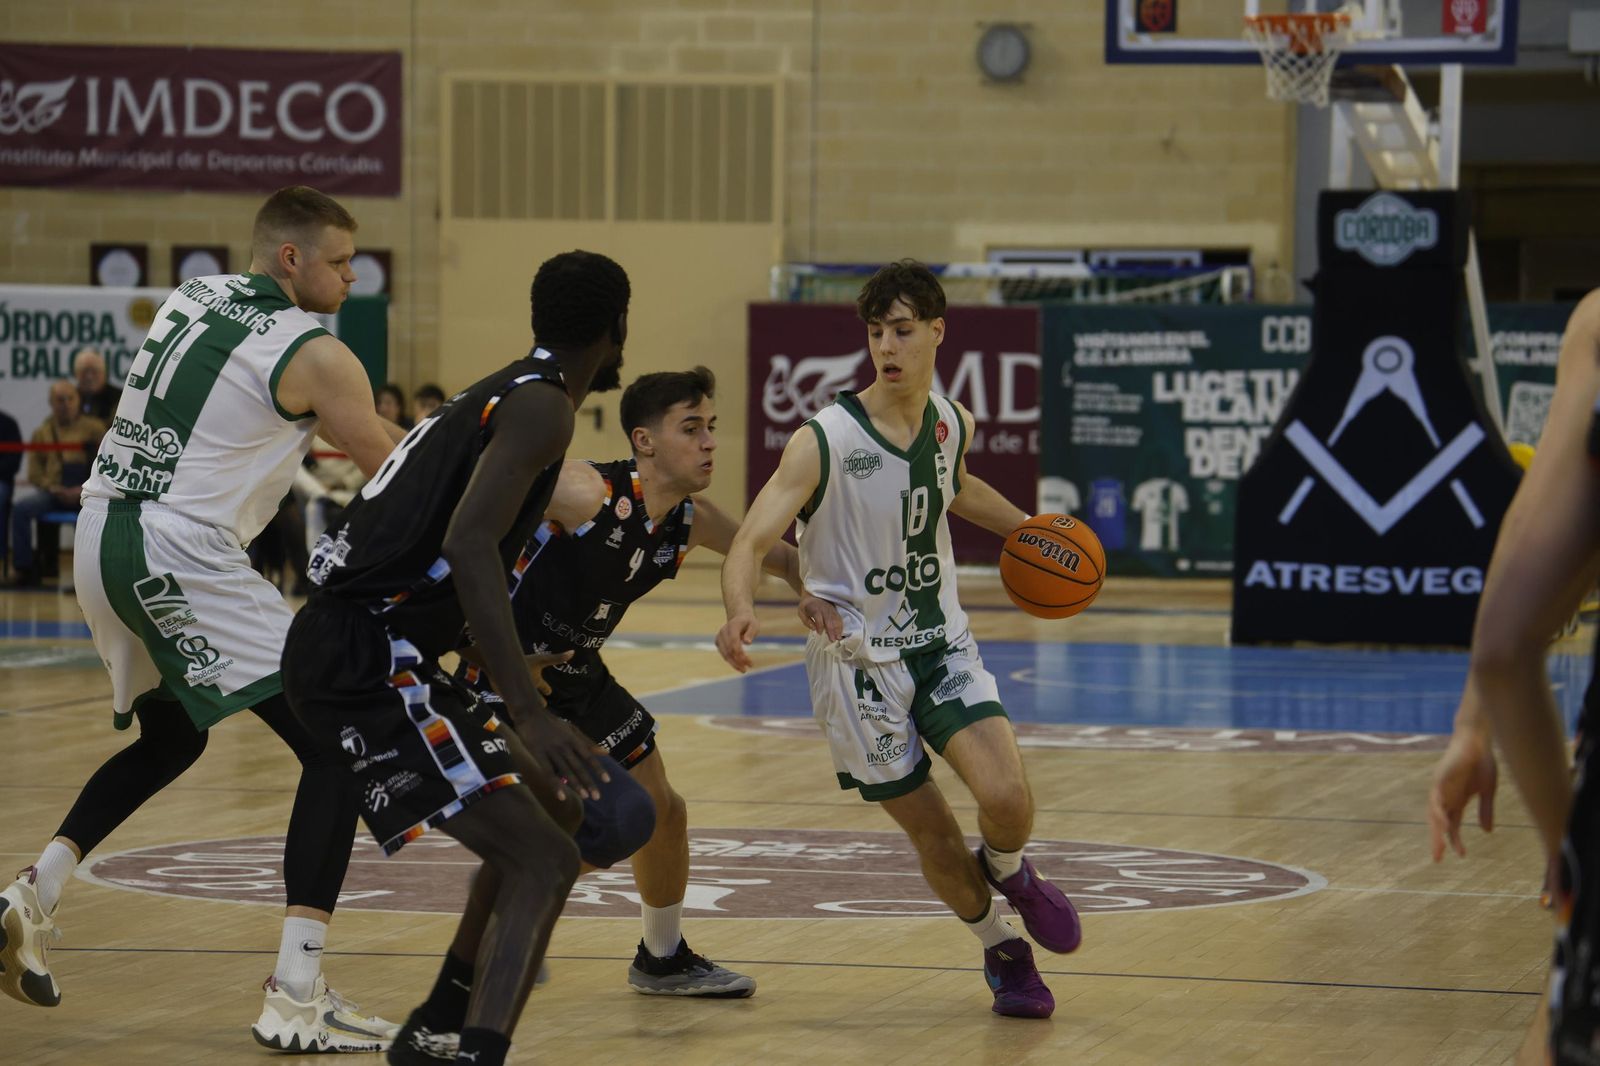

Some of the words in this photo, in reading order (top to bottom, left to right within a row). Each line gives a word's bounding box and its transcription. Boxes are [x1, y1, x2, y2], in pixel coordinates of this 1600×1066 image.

[85, 78, 387, 143] IMDECO
[0, 146, 75, 169] nstituto
[1017, 532, 1081, 573] Wilson
[864, 552, 941, 595] coto
[1245, 559, 1483, 595] ATRESVEG
[870, 626, 945, 648] RESVEGA
[866, 742, 907, 763] IMDECO
